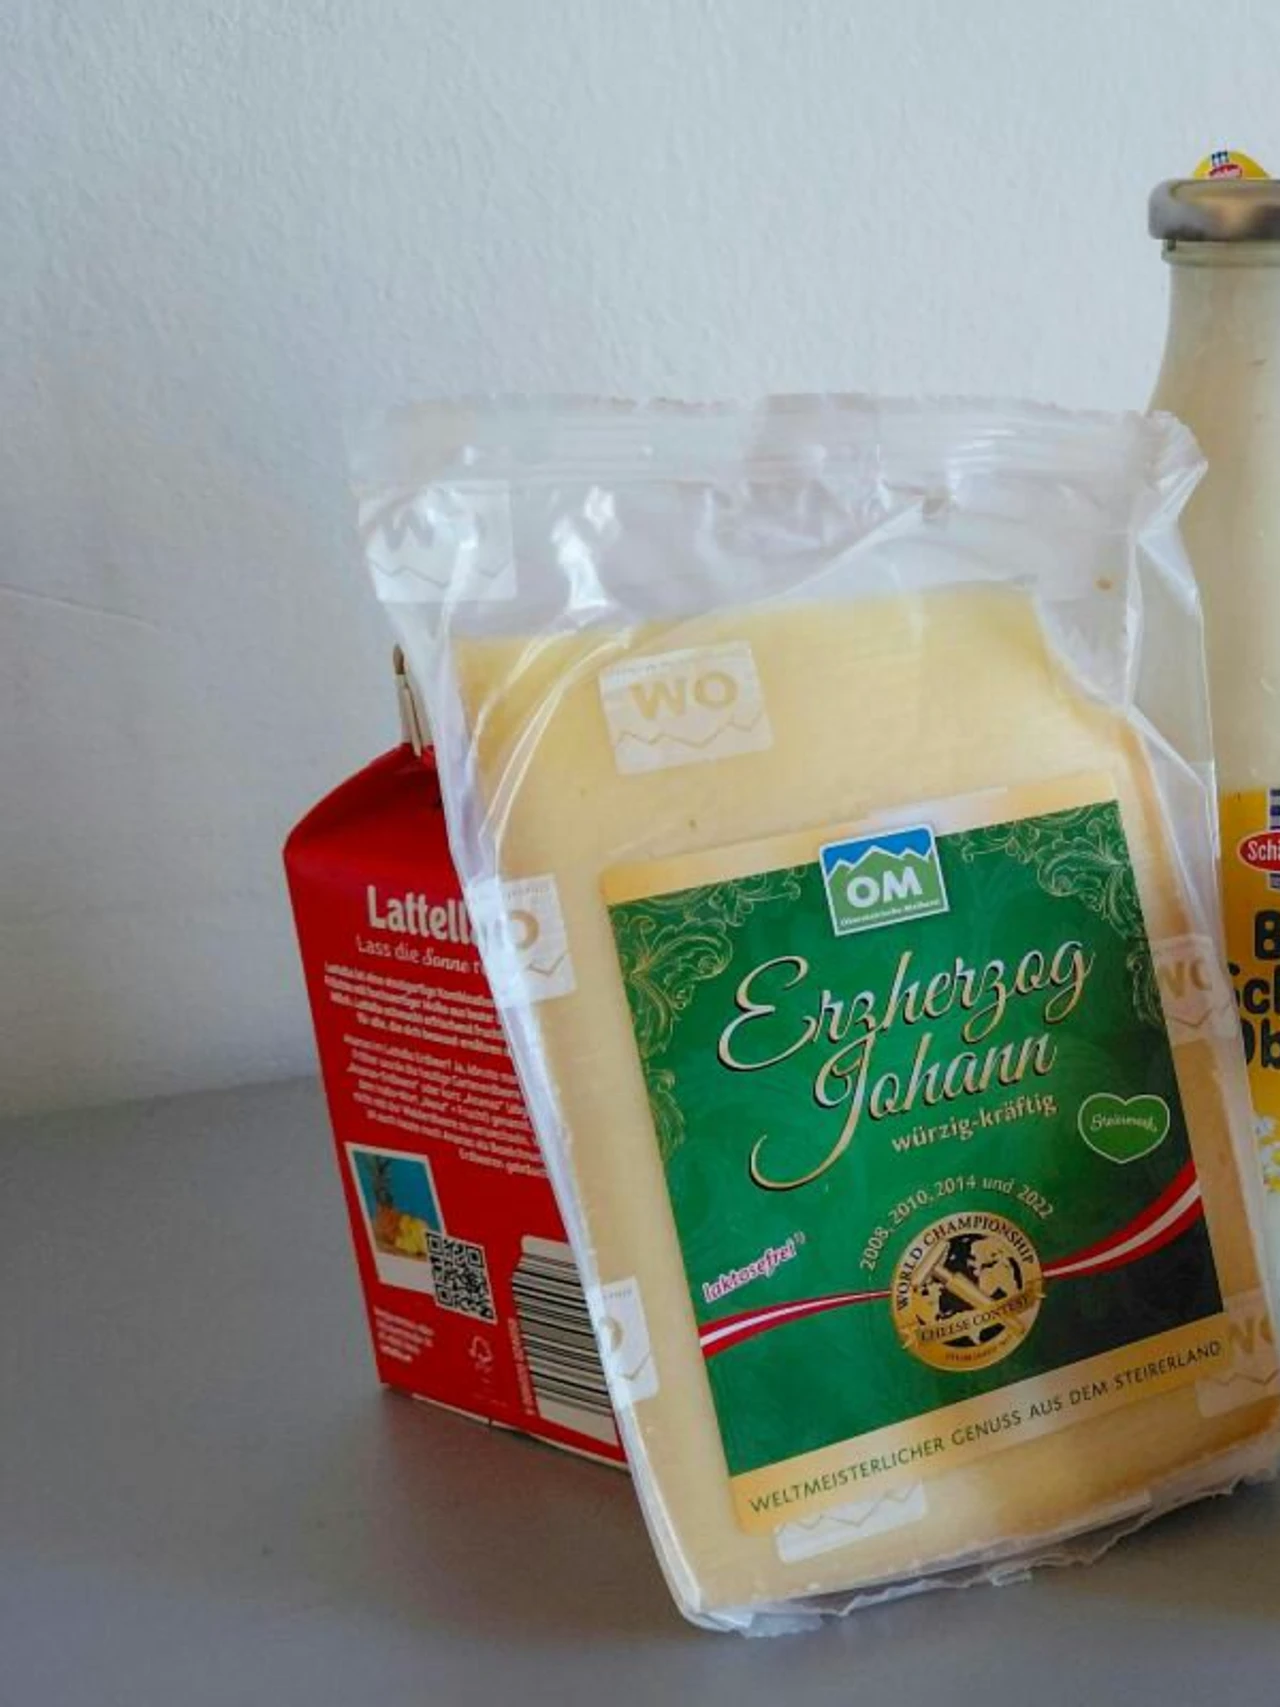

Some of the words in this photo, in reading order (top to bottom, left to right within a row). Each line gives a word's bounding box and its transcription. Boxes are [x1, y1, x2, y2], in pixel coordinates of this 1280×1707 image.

[367, 885, 475, 945] Lattell
[846, 867, 924, 909] OM
[394, 941, 420, 963] die
[717, 940, 1097, 1071] Erzherzog
[749, 1030, 1058, 1191] Johann
[891, 1092, 1058, 1154] würzig-kräftig
[888, 1189, 934, 1224] 2010,
[934, 1175, 977, 1198] 2014
[982, 1177, 1016, 1195] und
[1016, 1184, 1055, 1221] 2022
[896, 1248, 924, 1312] WORLD
[923, 1215, 1035, 1265] CHAMPIONSHIP
[921, 1318, 971, 1342] CHEESE
[751, 1437, 946, 1514] WELTMEISTERLICHER
[950, 1410, 1023, 1447] GENUSS
[1029, 1395, 1063, 1420] AUS
[1069, 1380, 1109, 1406] DEM
[1112, 1339, 1222, 1391] STEIRERLAND
